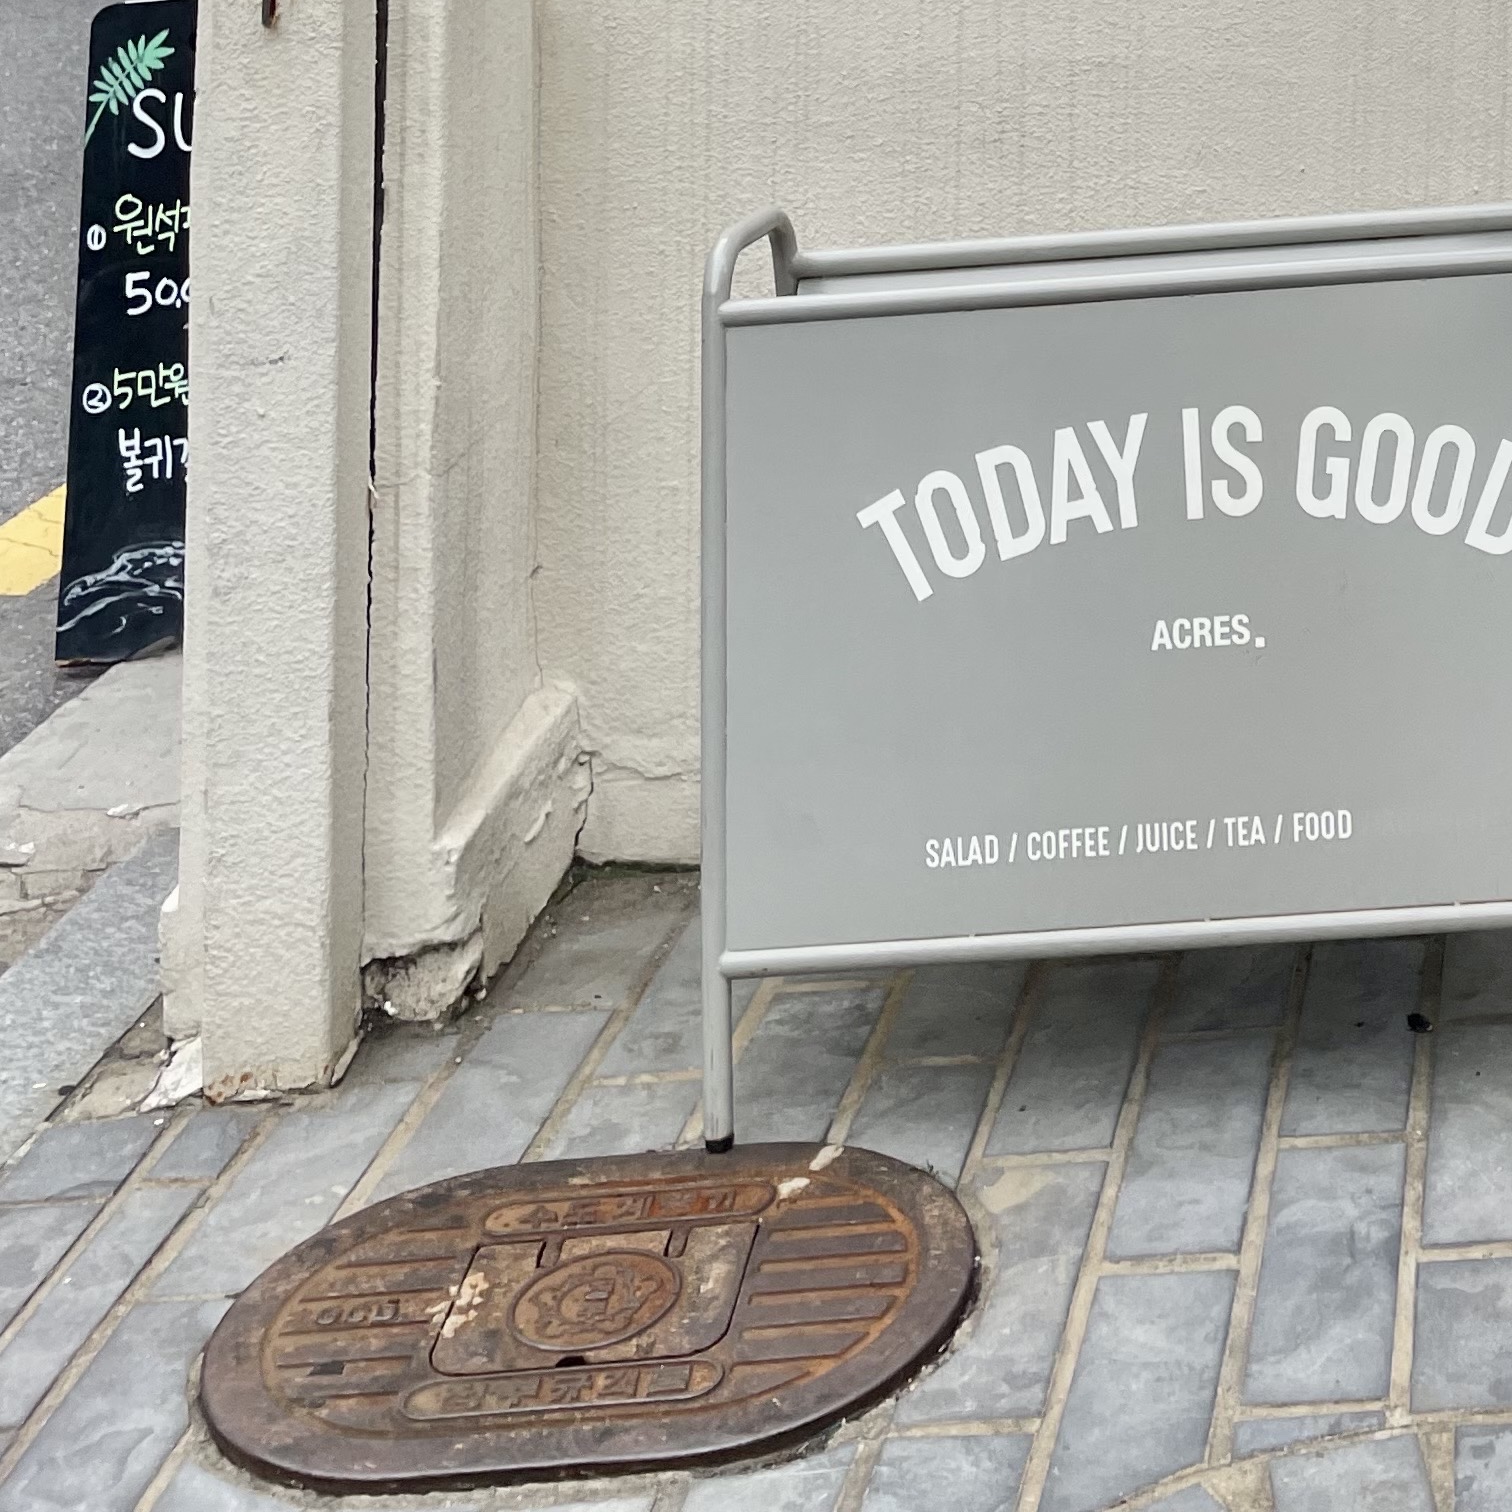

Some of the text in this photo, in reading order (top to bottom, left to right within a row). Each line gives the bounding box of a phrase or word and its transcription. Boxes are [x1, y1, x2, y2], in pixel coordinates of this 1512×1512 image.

[857, 413, 1149, 602] TODAY
[1181, 405, 1263, 520] IS
[1151, 613, 1266, 651] ACRES.
[925, 834, 999, 868] SALAD
[1027, 826, 1111, 861] COFFEE
[1135, 820, 1199, 853] JUICE
[1223, 815, 1266, 847] TEA
[1293, 809, 1352, 843] FOOD
